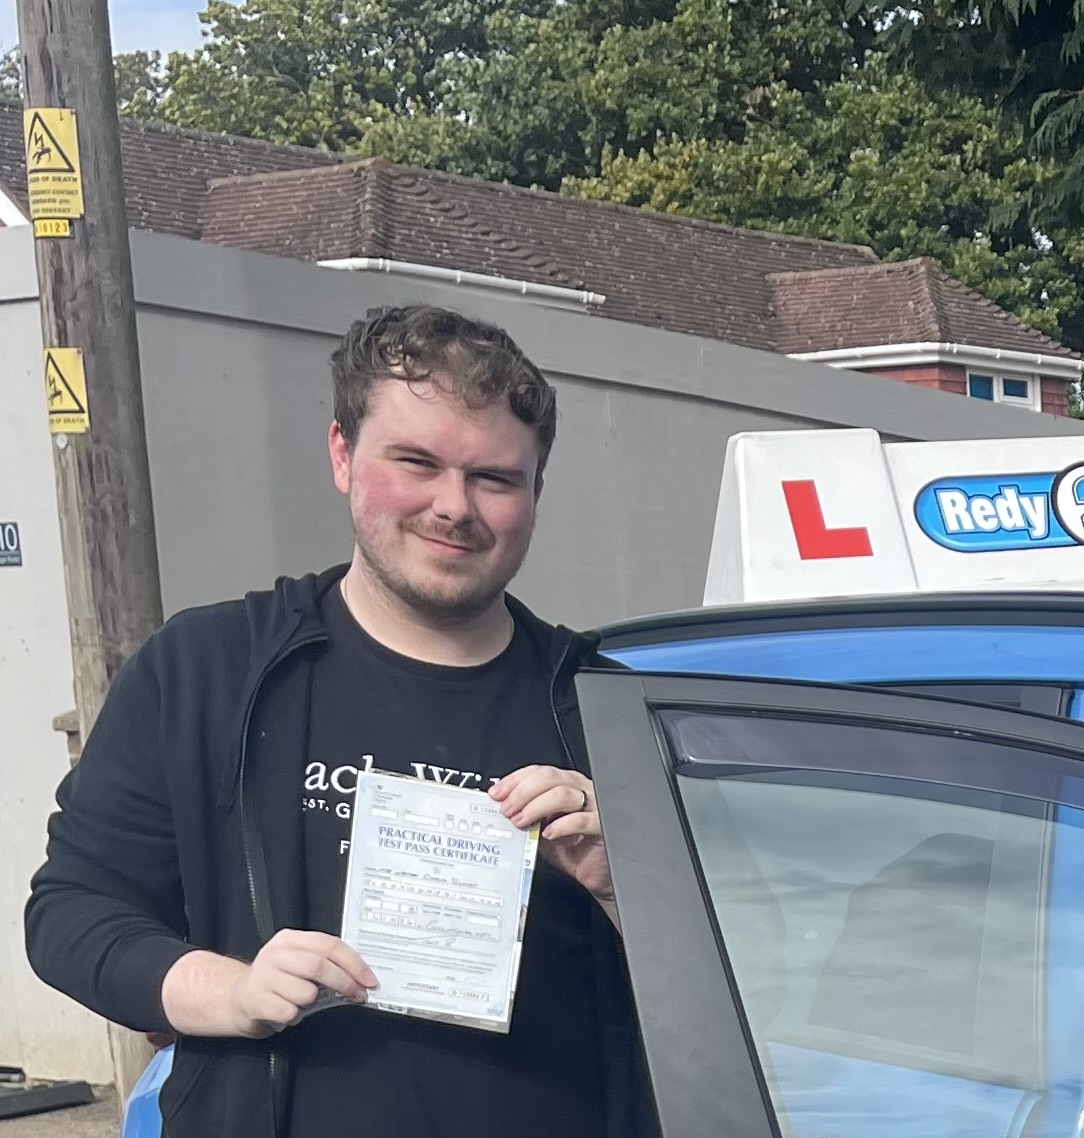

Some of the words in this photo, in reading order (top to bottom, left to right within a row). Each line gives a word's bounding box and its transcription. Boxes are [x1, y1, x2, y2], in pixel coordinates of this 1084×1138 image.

[781, 479, 874, 560] L
[938, 486, 1049, 540] Redy
[378, 826, 442, 846] PRACTICAL
[446, 837, 501, 855] DRIVING
[378, 837, 401, 850] TEST
[404, 842, 431, 854] PASS
[433, 847, 500, 866] CERTIFICATE
